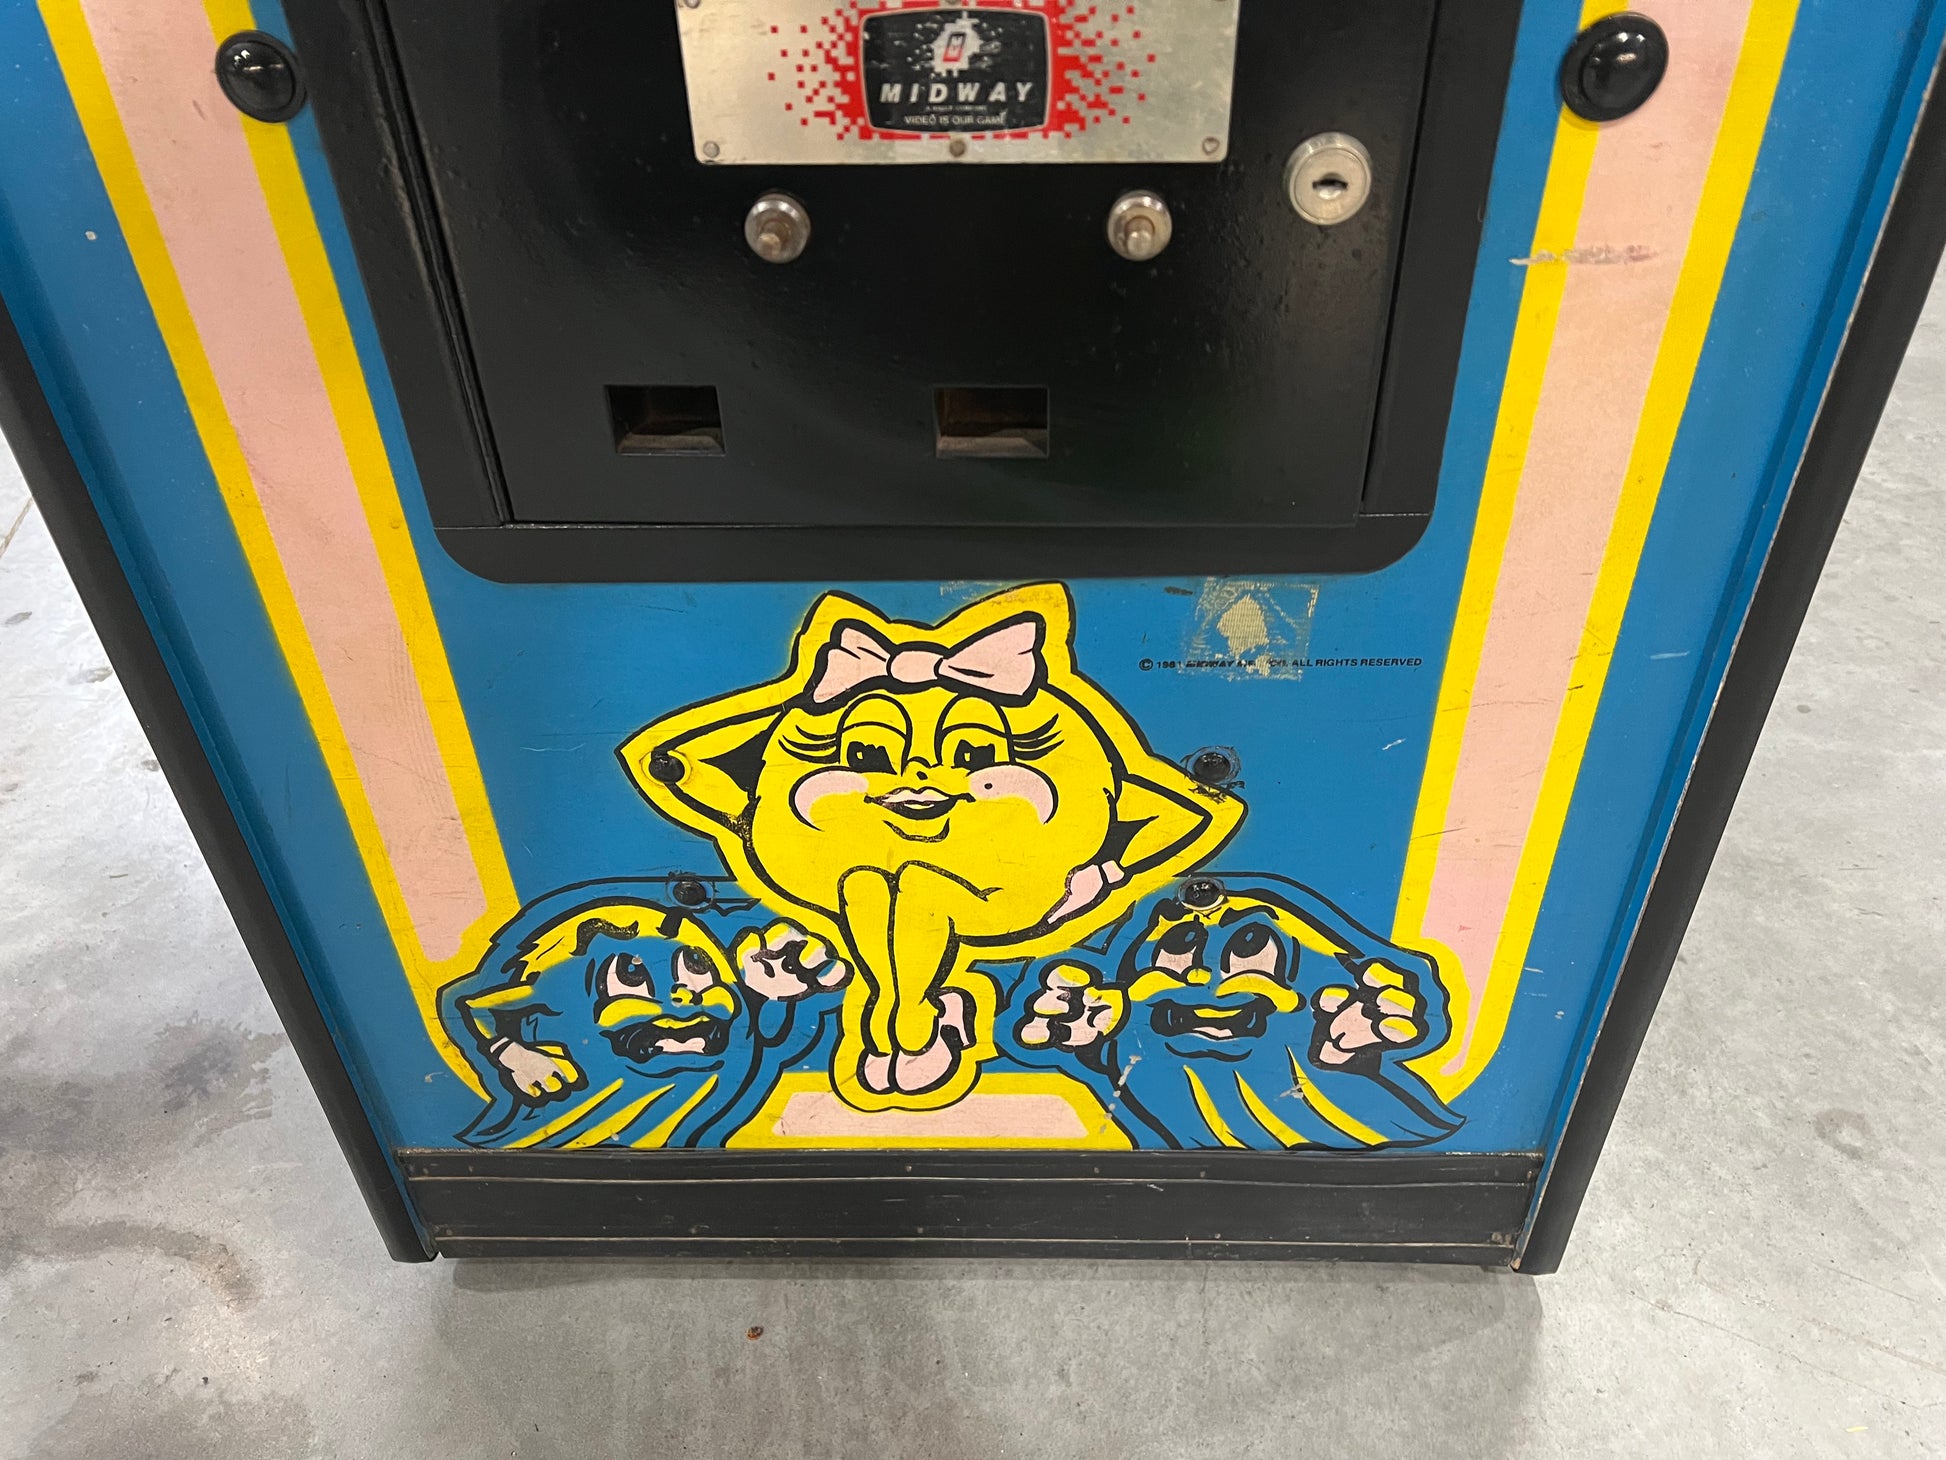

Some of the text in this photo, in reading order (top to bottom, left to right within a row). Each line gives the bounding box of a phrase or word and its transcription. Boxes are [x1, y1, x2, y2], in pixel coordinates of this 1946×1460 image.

[880, 82, 1033, 103] MIDWAY
[939, 115, 950, 126] IS
[952, 115, 974, 126] OUR
[1292, 658, 1313, 667] ALL
[1315, 658, 1358, 667] RIGHTS
[1360, 658, 1422, 667] RESERVED
